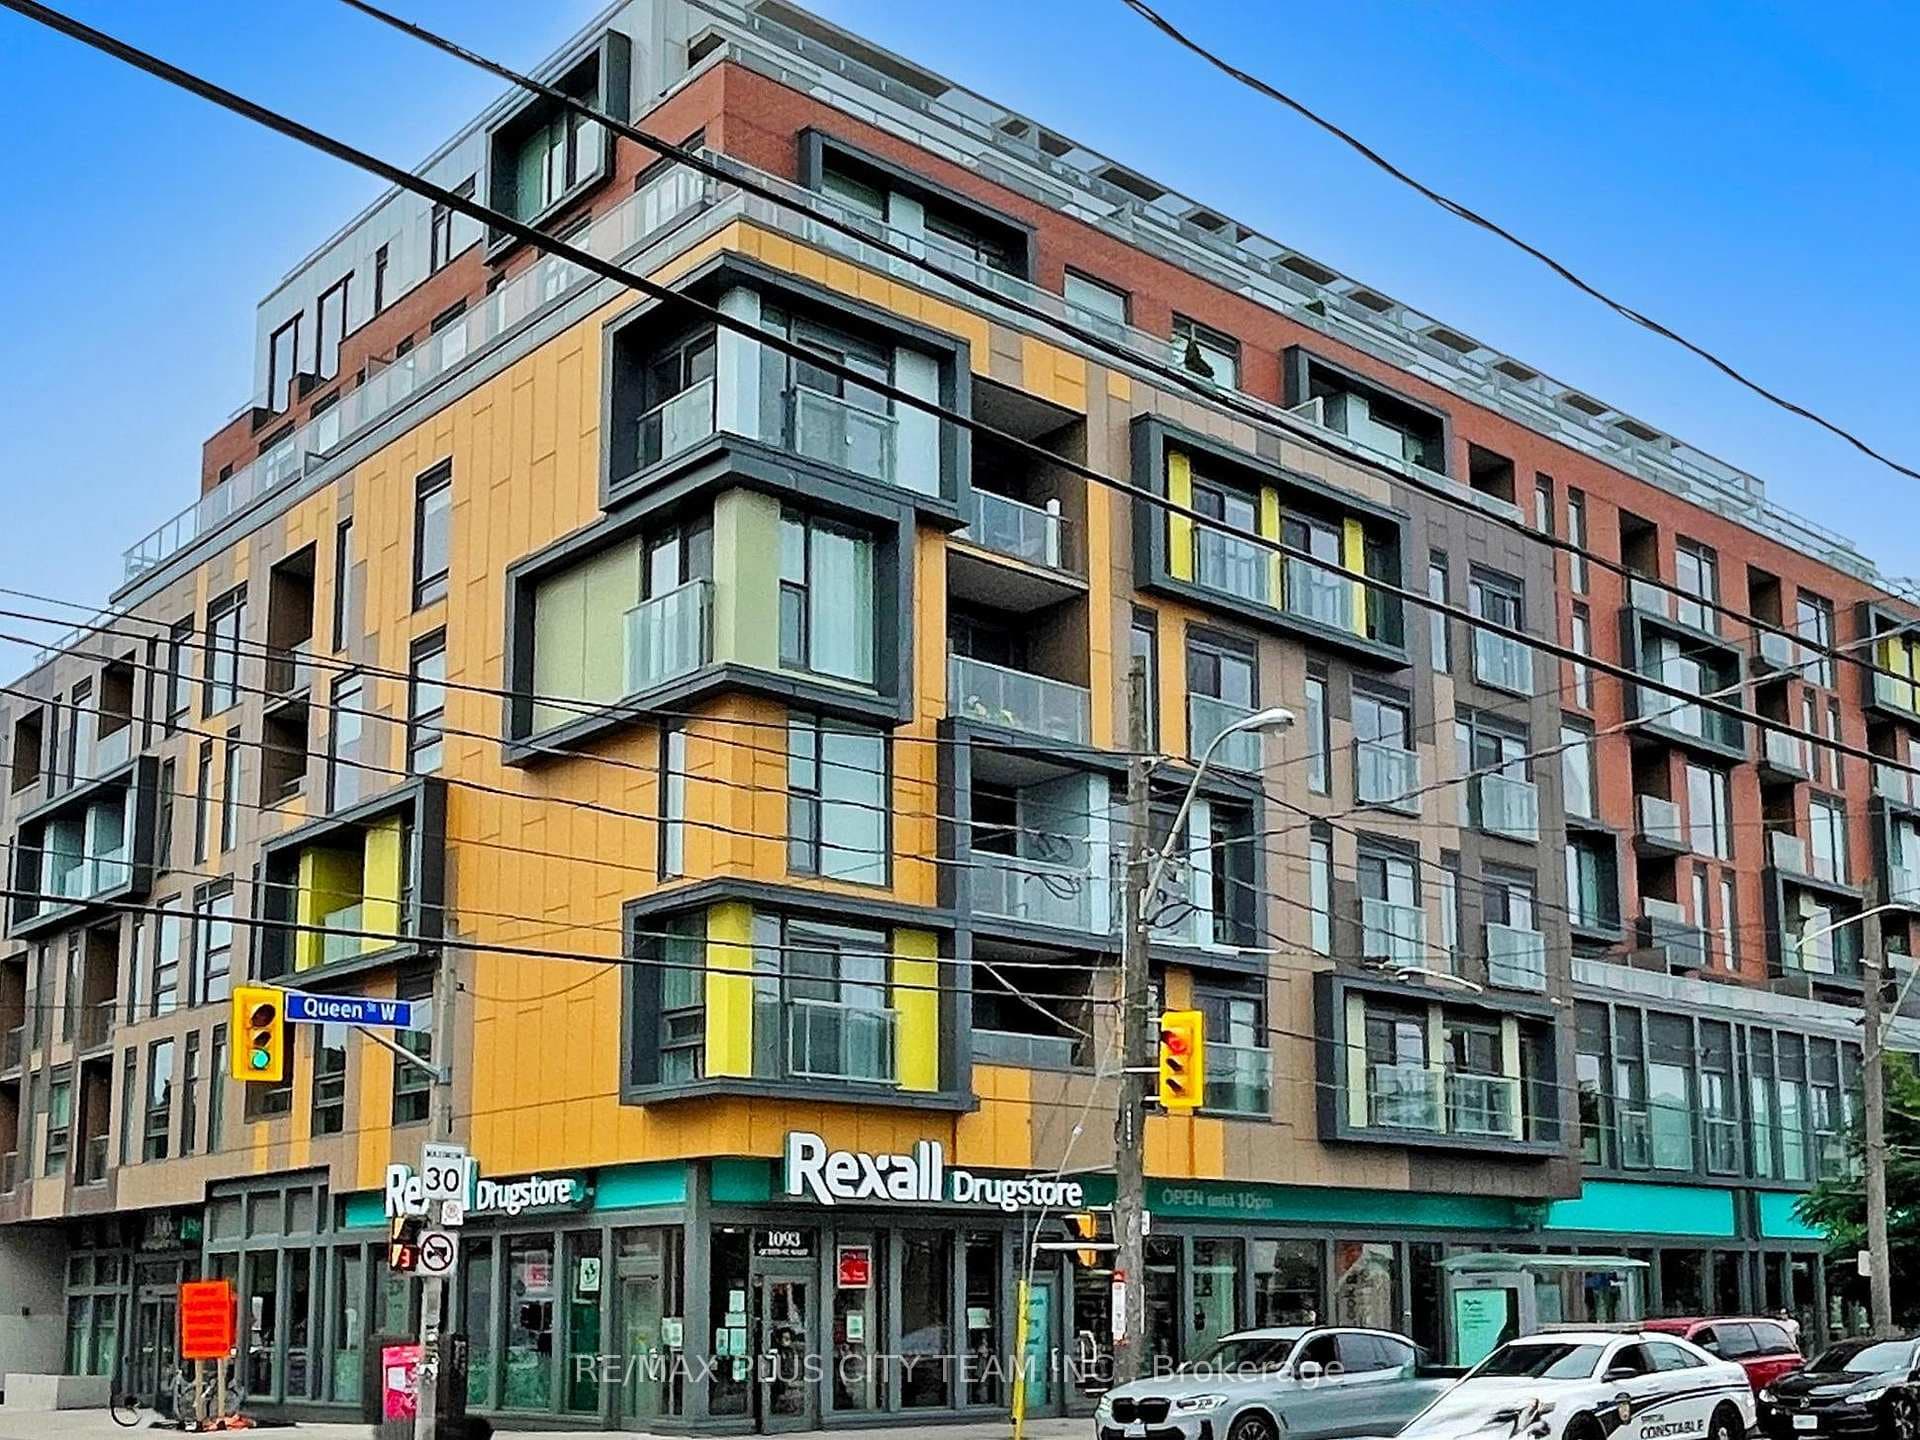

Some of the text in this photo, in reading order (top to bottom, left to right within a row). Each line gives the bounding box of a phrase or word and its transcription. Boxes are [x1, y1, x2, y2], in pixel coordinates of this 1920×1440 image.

[304, 998, 363, 1019] Queen
[381, 1003, 396, 1021] W
[426, 1167, 460, 1192] 30
[787, 1132, 1084, 1213] Rexall Drugstore
[477, 1176, 576, 1216] Drugstore
[1161, 1187, 1204, 1207] OPEN
[767, 1230, 801, 1248] 1093
[1640, 1419, 1704, 1440] CONSTABLE
